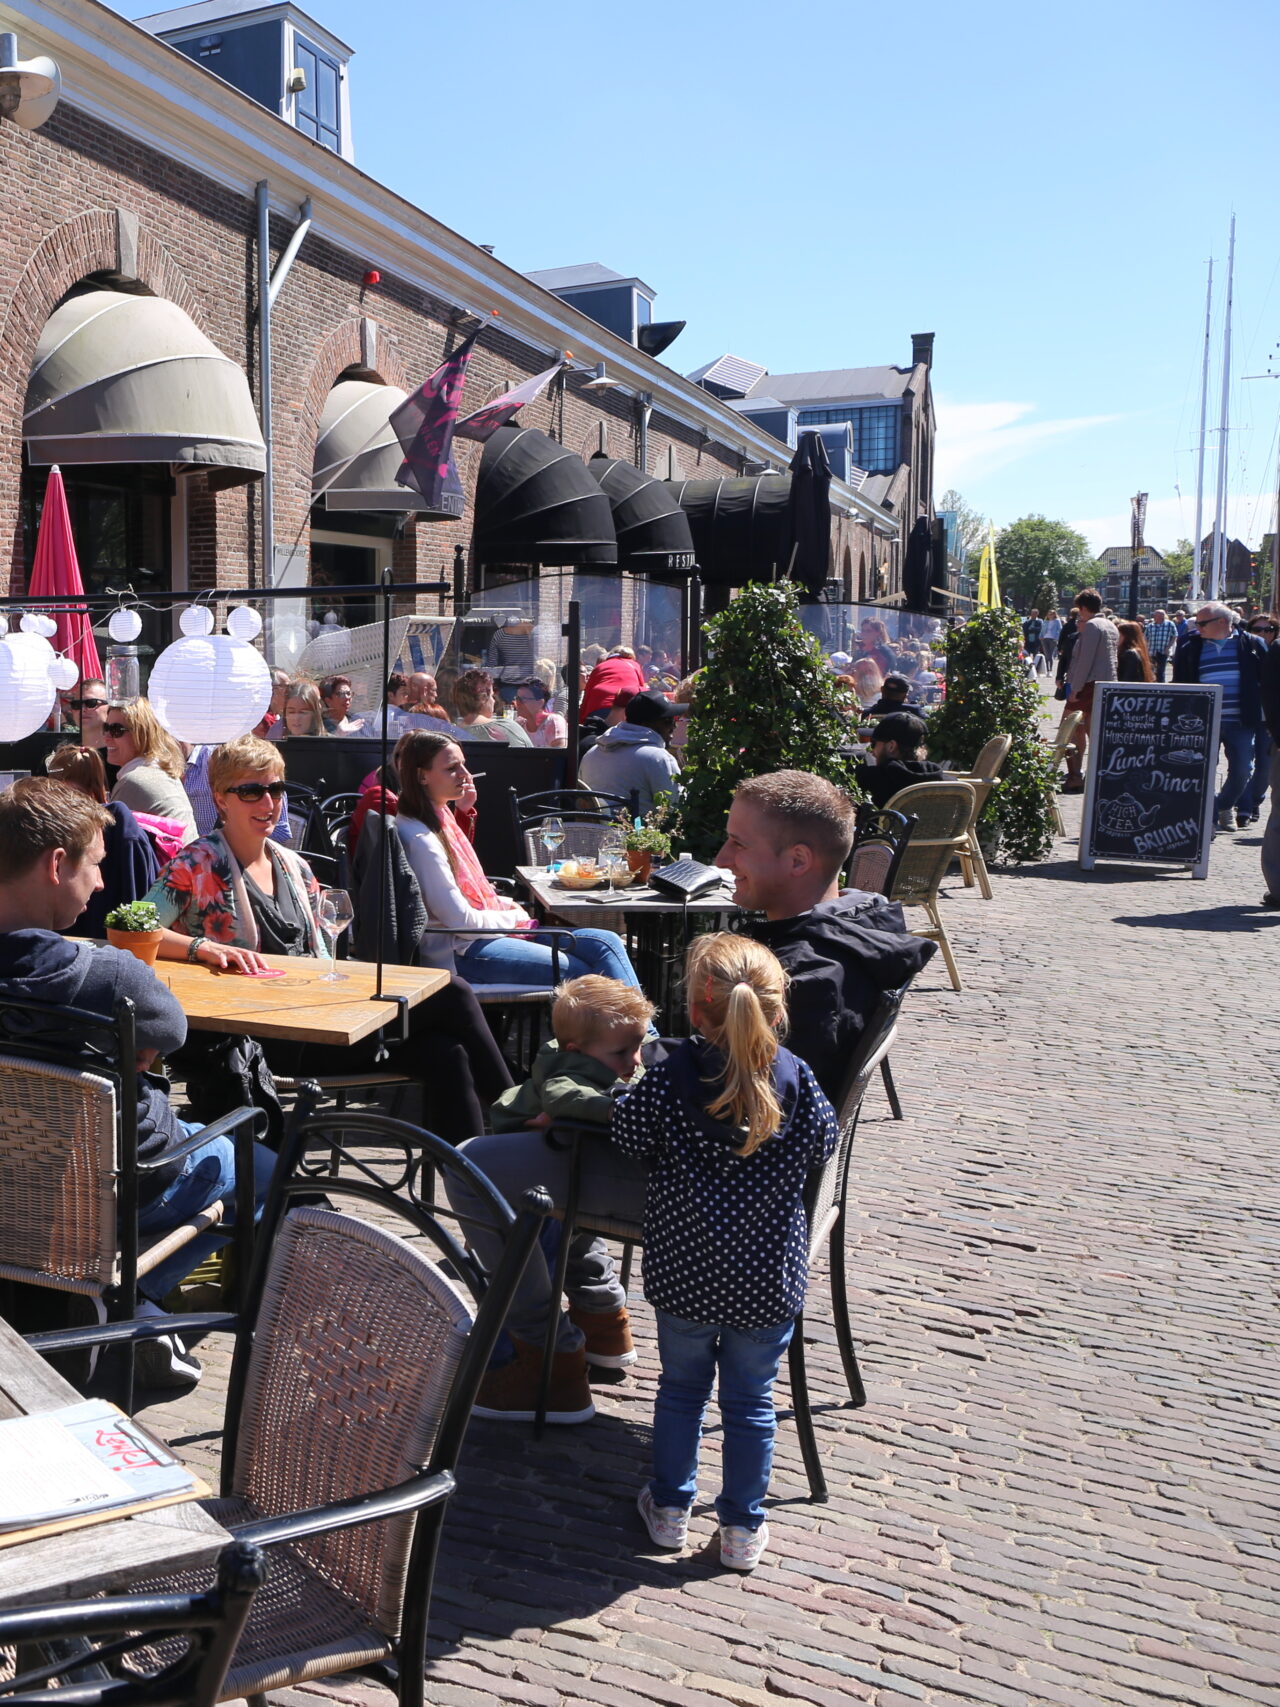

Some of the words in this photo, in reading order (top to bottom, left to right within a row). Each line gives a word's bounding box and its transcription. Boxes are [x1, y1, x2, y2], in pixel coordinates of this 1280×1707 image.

[1111, 696, 1174, 713] KOFFIE
[1105, 730, 1166, 746] HUISGEMAAKTE
[1169, 732, 1204, 748] TAARTEN
[1098, 746, 1155, 775] Lunch
[1142, 770, 1201, 792] Diner
[1109, 803, 1137, 818] HIGH
[1106, 815, 1135, 830] TEA
[1134, 818, 1199, 853] BRUNCH
[95, 1429, 161, 1472] Leuk!
